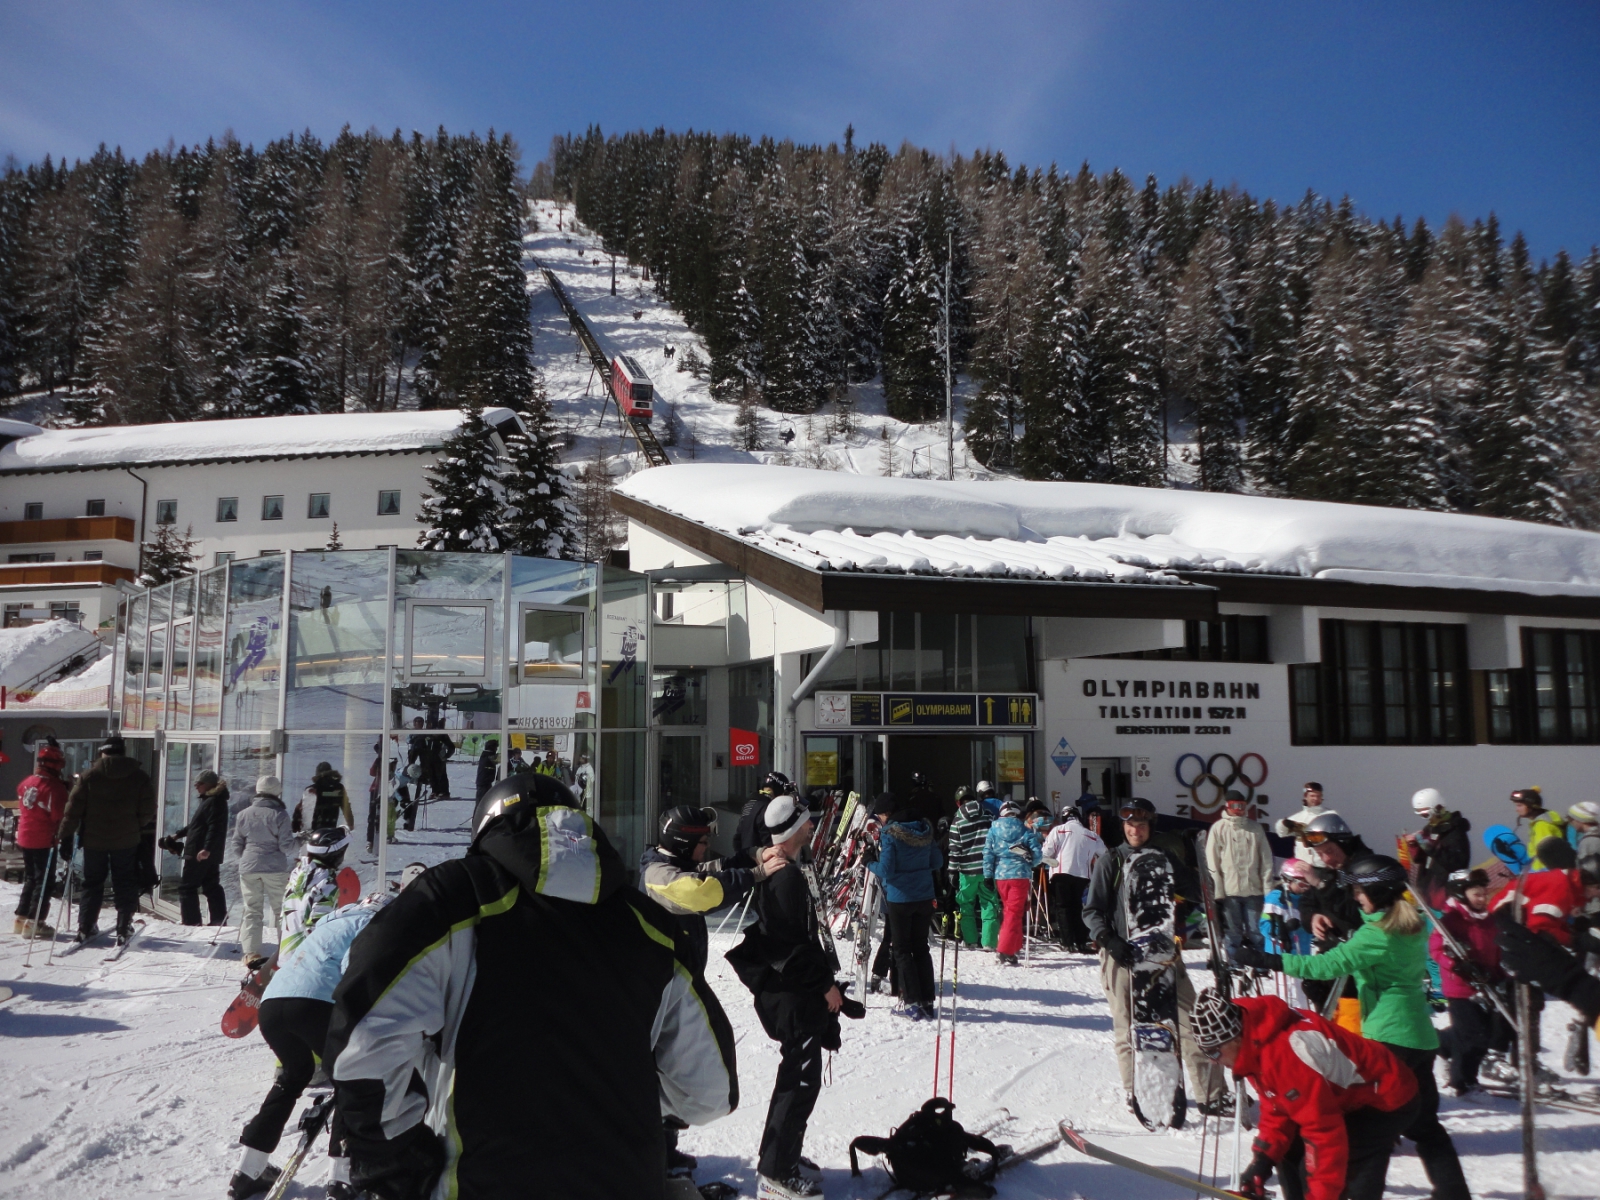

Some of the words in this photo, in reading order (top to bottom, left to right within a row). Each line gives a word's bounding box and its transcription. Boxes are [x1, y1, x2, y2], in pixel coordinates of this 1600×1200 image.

[1082, 679, 1260, 700] OLYMPIABAHN
[916, 704, 972, 716] OLYMPIABAHN
[1098, 705, 1203, 719] TALSTATION
[1115, 725, 1191, 735] BERGSTATION
